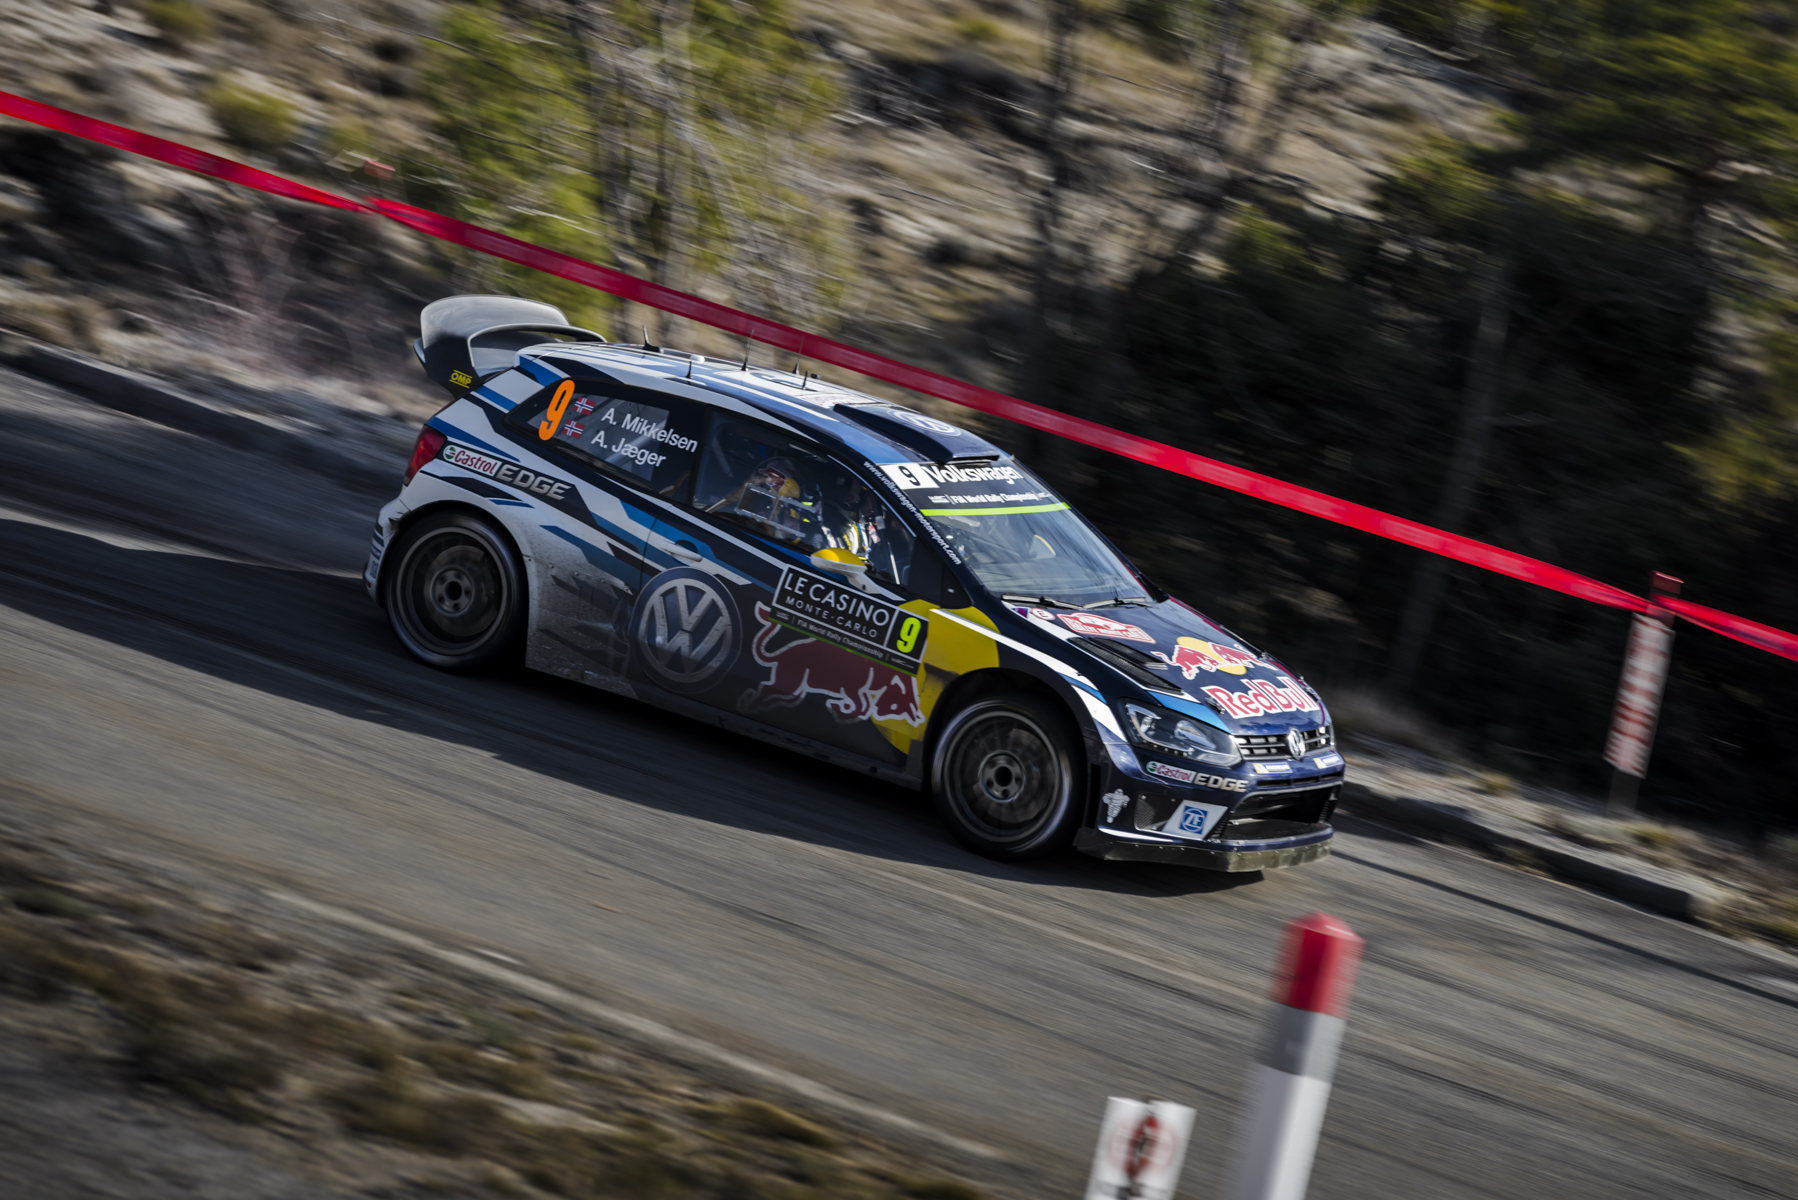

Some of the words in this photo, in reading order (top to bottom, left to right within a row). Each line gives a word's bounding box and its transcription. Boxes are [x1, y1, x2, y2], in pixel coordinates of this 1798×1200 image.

[451, 372, 472, 385] OMP
[538, 380, 576, 440] 9
[590, 430, 608, 449] A.
[611, 438, 667, 467] Jæger
[600, 407, 617, 425] A.
[621, 413, 698, 453] Mikkelsen
[453, 449, 498, 475] Castrol
[495, 464, 572, 500] EDGE
[898, 465, 921, 487] 9
[922, 465, 1024, 485] Volkswagen
[863, 460, 962, 566] www.volkswagen-motorsport.com
[784, 572, 808, 595] LE
[809, 583, 890, 627] CASINO
[797, 619, 808, 629] FIA
[808, 623, 826, 636] World
[826, 630, 842, 643] Rally
[842, 635, 884, 658] Championship
[896, 617, 921, 653] 9
[1203, 680, 1281, 717] Red
[1253, 677, 1319, 710] Bull
[1156, 764, 1193, 782] Castrol
[1194, 772, 1250, 793] EDGE
[1184, 811, 1204, 829] ZF
